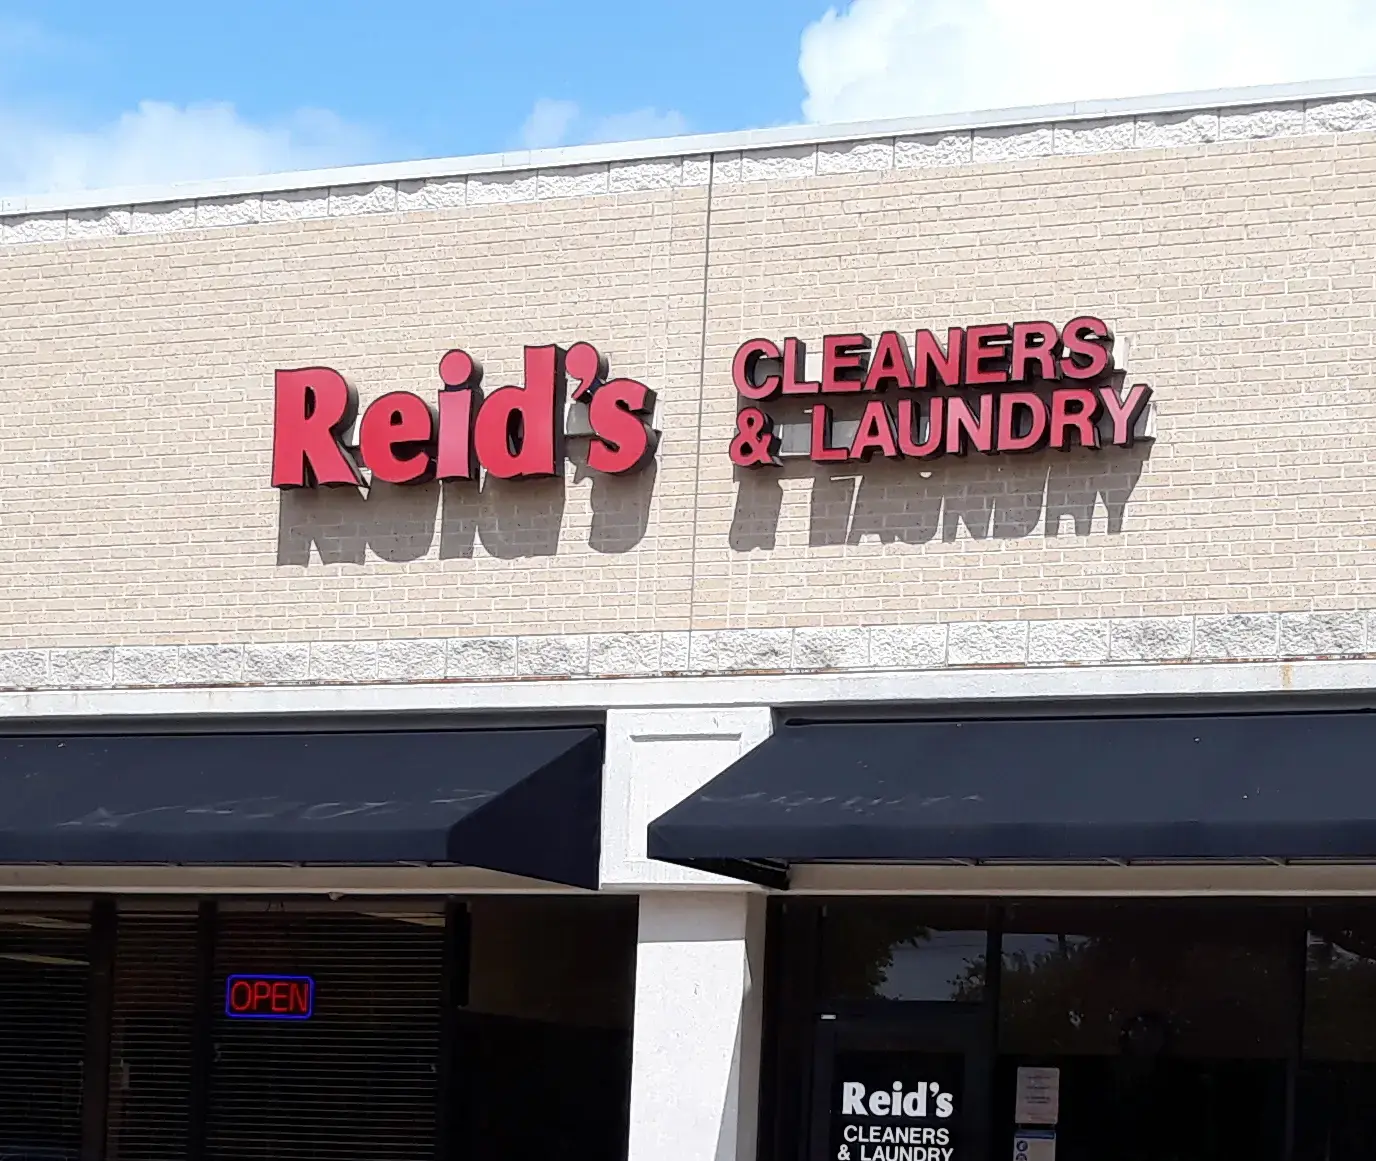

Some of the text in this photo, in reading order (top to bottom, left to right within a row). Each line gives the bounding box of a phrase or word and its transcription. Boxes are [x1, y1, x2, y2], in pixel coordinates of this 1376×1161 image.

[730, 315, 1113, 398] CLEANERS
[271, 341, 657, 489] Reid's
[728, 384, 1154, 469] & LAUNDRY
[231, 981, 309, 1012] OPEN
[842, 1081, 954, 1118] Reid's
[837, 1144, 851, 1161] &
[843, 1125, 950, 1145] CLEANERS
